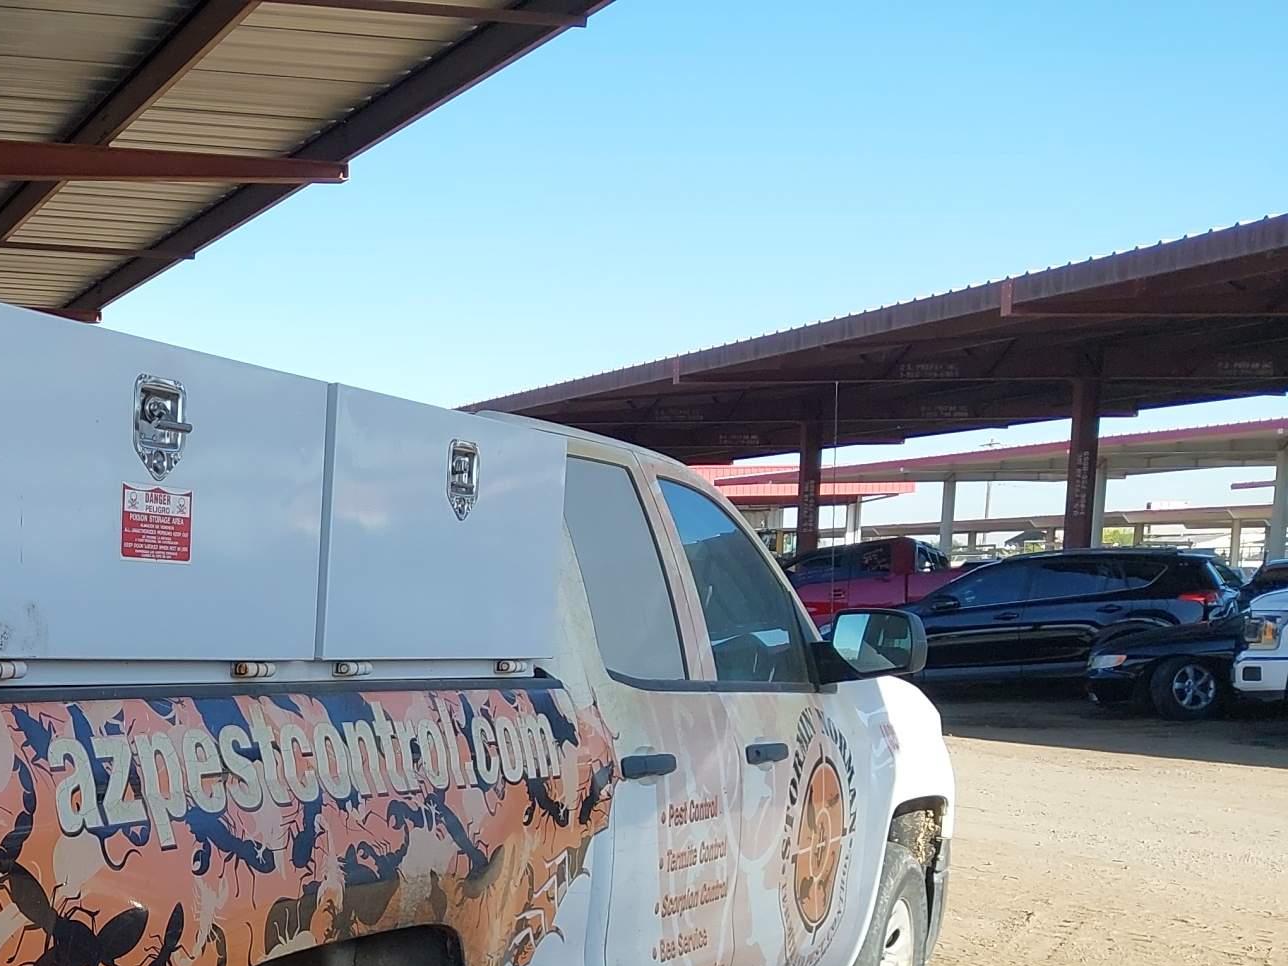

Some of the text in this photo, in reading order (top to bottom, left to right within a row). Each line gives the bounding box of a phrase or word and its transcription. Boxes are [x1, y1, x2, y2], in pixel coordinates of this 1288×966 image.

[145, 492, 171, 506] DANGER
[145, 504, 171, 514] PELIGRO
[49, 704, 562, 851] azpestcontrol.com
[668, 794, 718, 828] Pest Control
[666, 834, 727, 873] Termite Control
[661, 876, 728, 918] Scorpion Control
[659, 927, 708, 963] Bee Service
